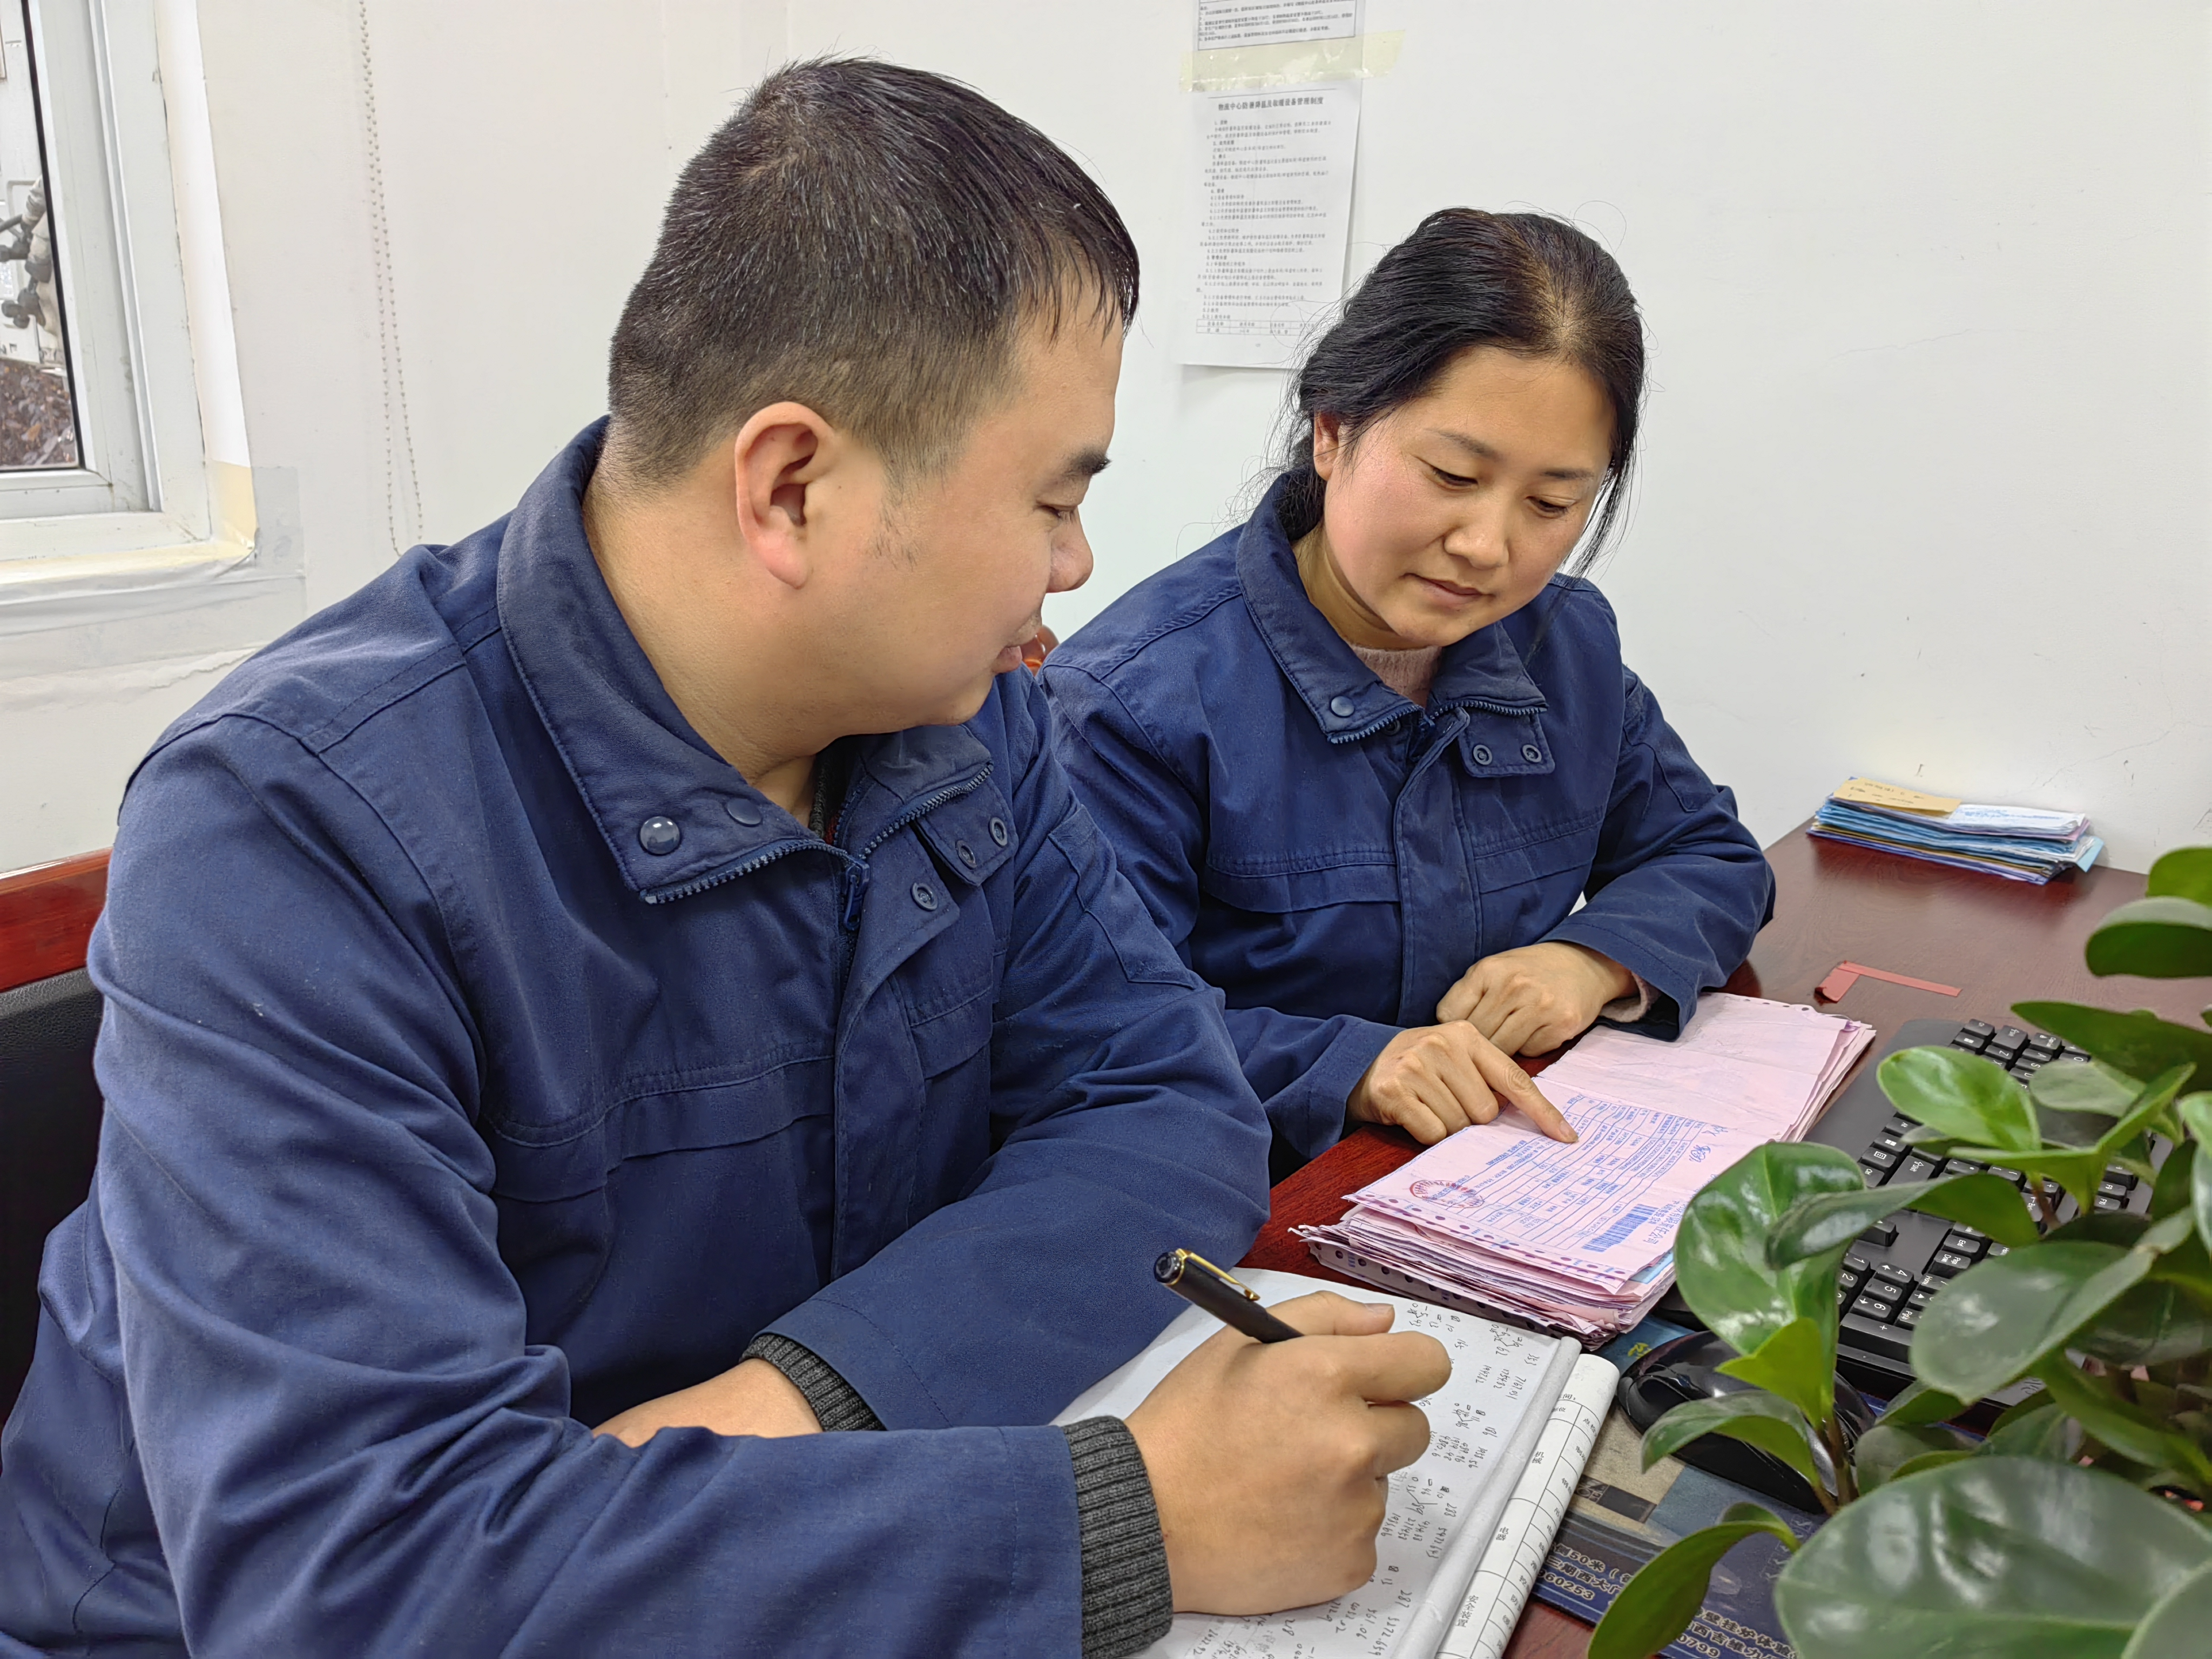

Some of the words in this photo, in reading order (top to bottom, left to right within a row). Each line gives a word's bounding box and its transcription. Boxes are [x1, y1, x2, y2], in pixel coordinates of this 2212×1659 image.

[1842, 1273, 1854, 1281] 2
[1496, 1346, 1510, 1355] 62
[1524, 1353, 1540, 1365] 353
[1532, 1451, 1544, 1464] 机械
[1395, 1589, 1413, 1608] 287
[1455, 1595, 1479, 1628] 安全装置
